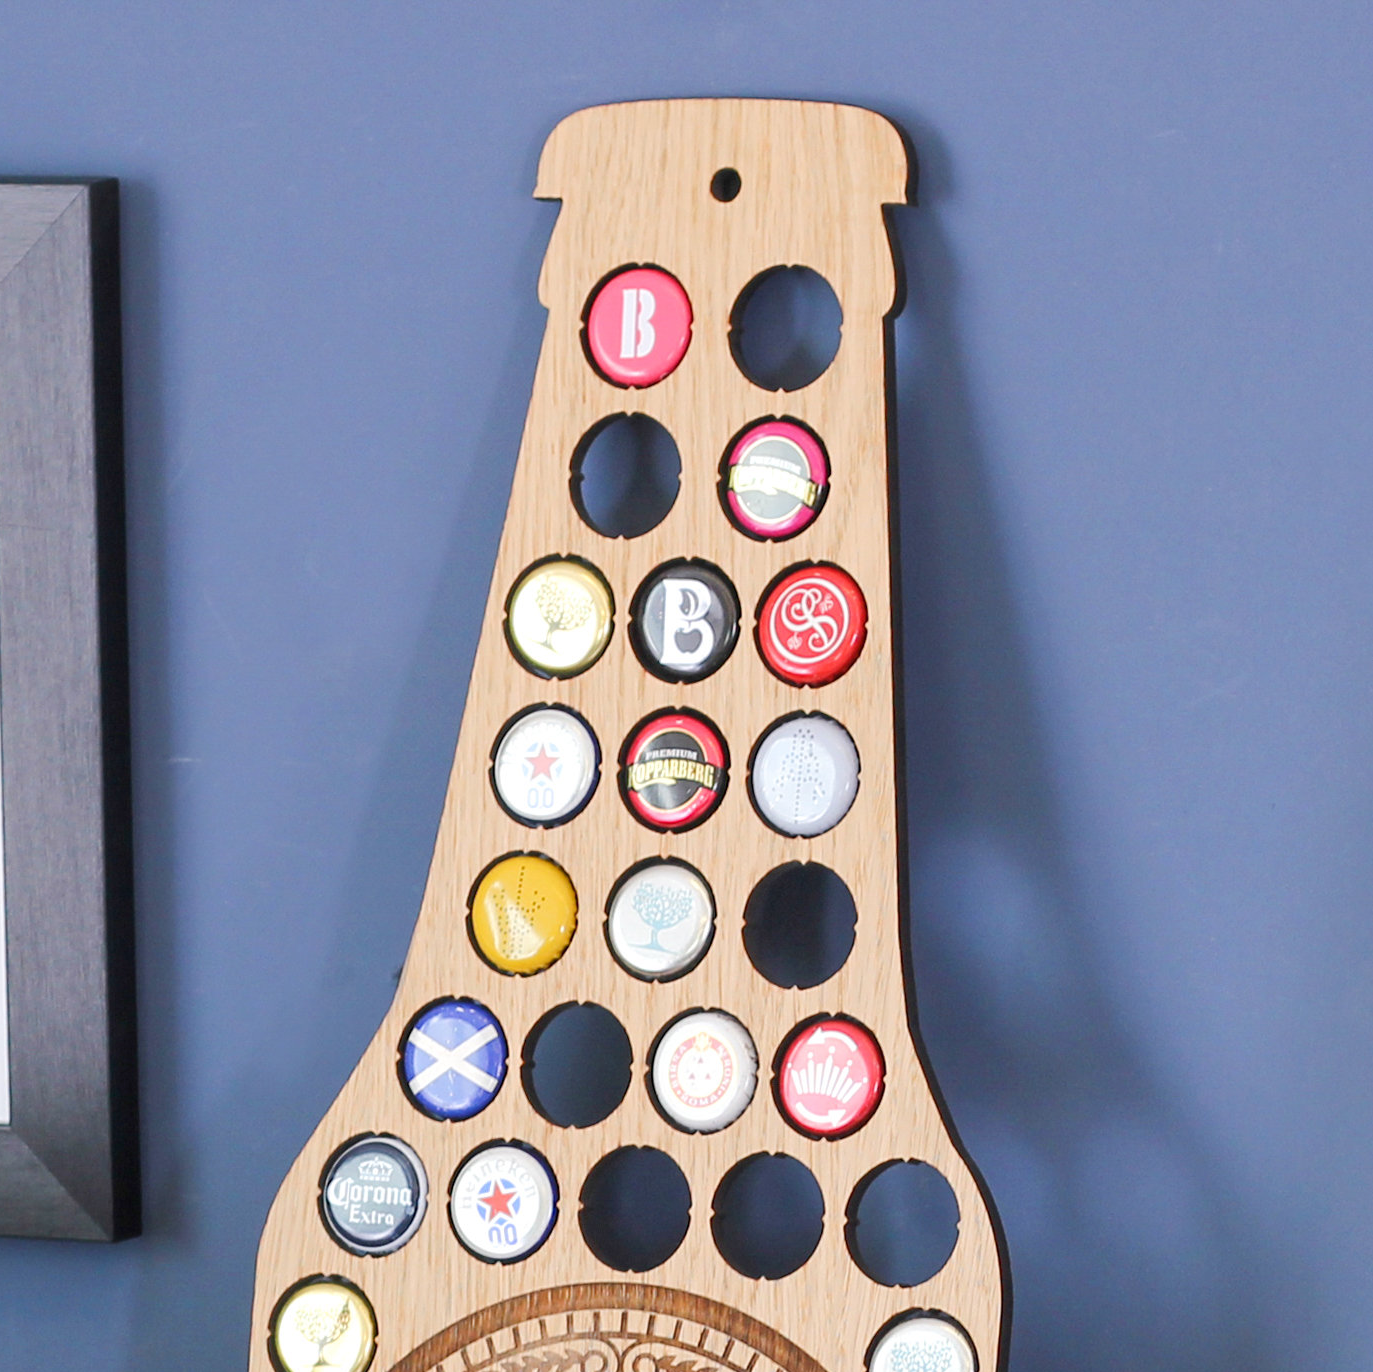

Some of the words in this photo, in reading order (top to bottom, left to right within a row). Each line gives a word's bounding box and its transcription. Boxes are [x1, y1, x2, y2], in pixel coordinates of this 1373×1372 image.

[645, 748, 698, 761] PREMIUM
[628, 758, 715, 792] KOPPARBERG
[327, 1177, 413, 1211] Corona
[349, 1203, 395, 1225] Extra
